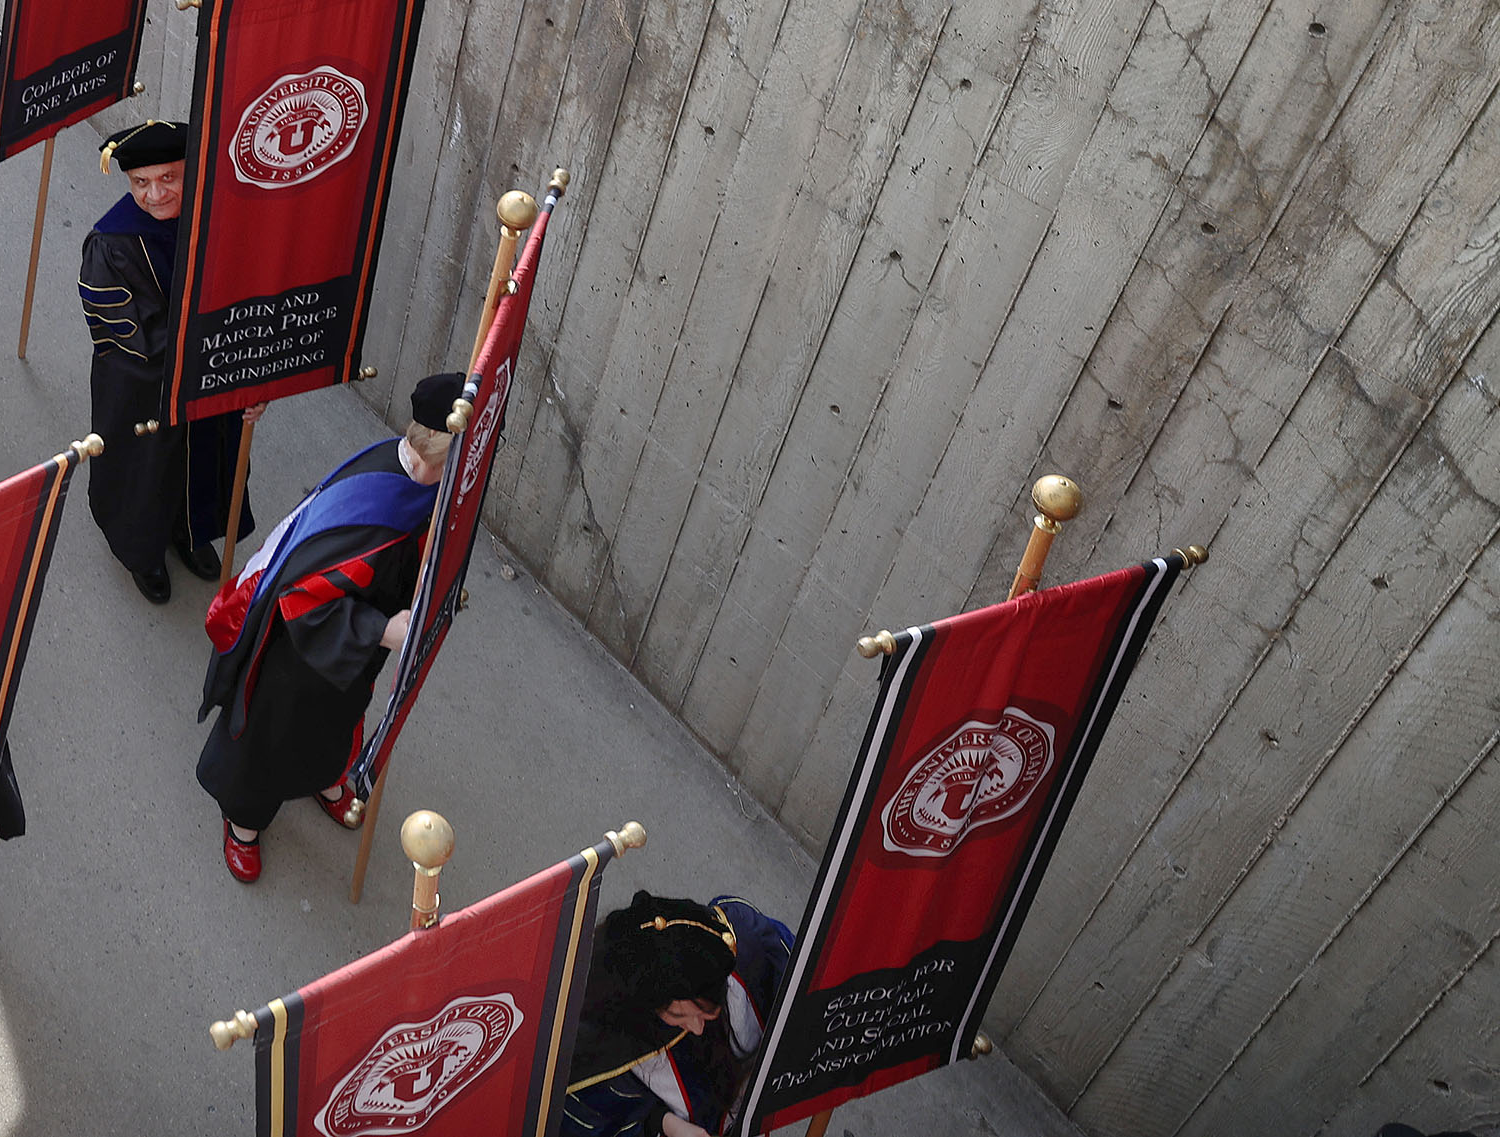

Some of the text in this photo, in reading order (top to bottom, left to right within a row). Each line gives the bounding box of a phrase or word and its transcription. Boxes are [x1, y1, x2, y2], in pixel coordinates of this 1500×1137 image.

[21, 50, 117, 104] COLLEGE OF
[23, 74, 107, 125] FINE ARTS
[240, 76, 360, 157] THE UNIVERSITY OF UTAH
[269, 161, 314, 181] 1850
[223, 292, 319, 325] JOHN AND
[200, 306, 338, 353] MARCIA PRICE
[209, 329, 324, 369] COLLEGE OF
[200, 349, 325, 390] ENGINEERING
[1016, 727, 1038, 745] OF
[1023, 744, 1044, 783] UTAH
[895, 787, 918, 822] THE
[334, 1098, 352, 1127] THE
[466, 1005, 490, 1017] OF
[485, 1009, 505, 1043] UTAH
[810, 1036, 855, 1062] AND
